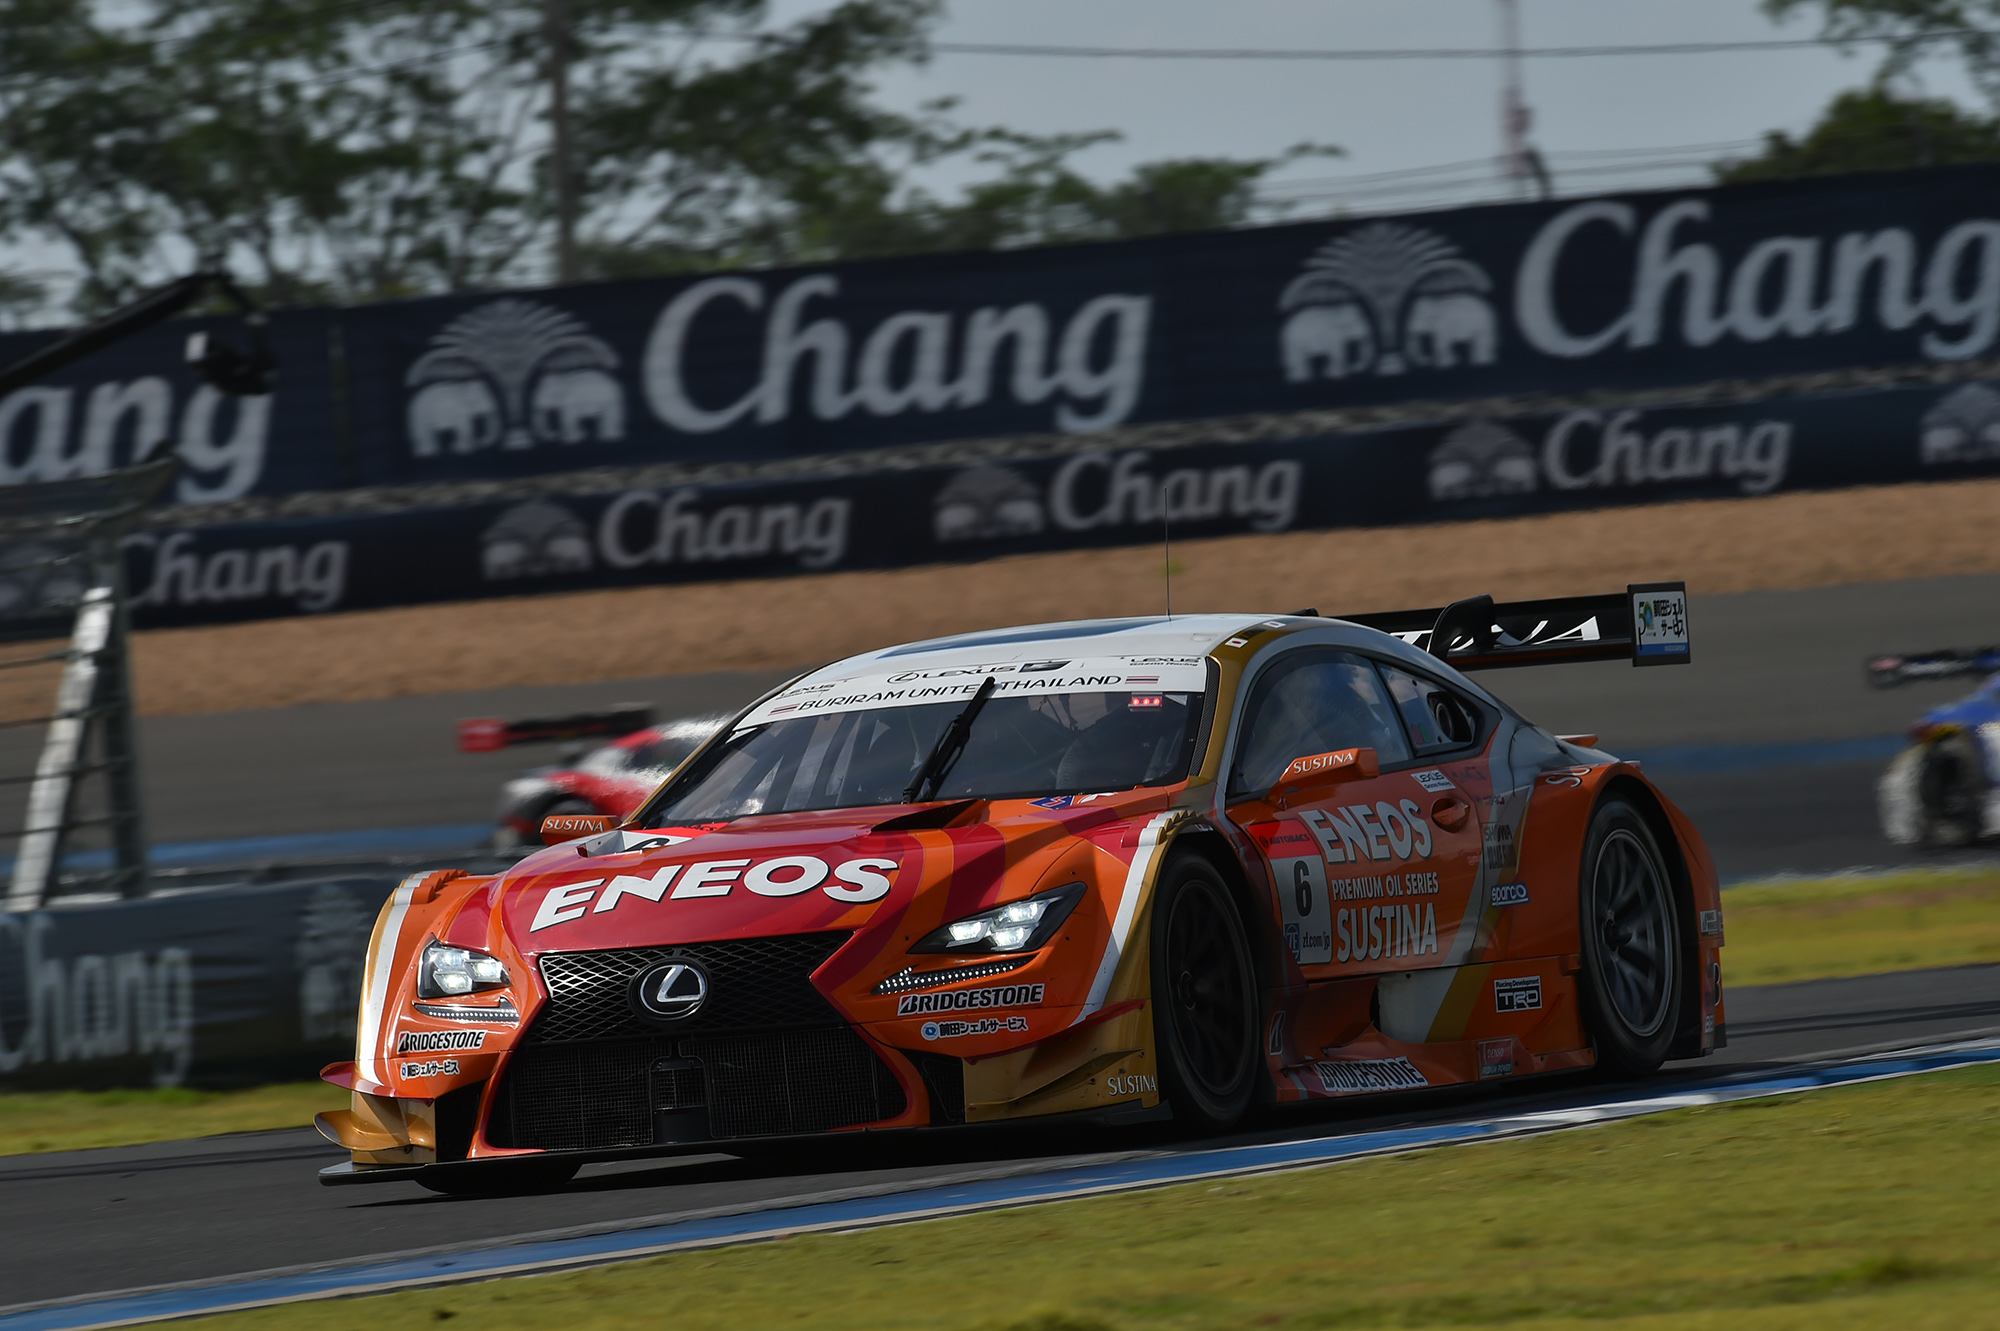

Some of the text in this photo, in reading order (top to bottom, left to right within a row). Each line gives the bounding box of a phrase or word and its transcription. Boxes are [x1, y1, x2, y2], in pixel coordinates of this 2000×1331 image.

[1511, 198, 2000, 360] Chang
[642, 274, 1154, 435] Chang
[1541, 408, 1794, 495] Chang
[1050, 450, 1302, 532] Chang
[598, 487, 852, 568] Chang
[921, 664, 1017, 679] LEXUS
[798, 690, 904, 712] BURIRAM
[908, 684, 981, 699] UNITE
[1001, 676, 1121, 691] THAILAND
[1293, 752, 1354, 775] SUSTINA
[545, 819, 604, 832] SUSTINA
[1299, 798, 1432, 864] ENEOS
[530, 856, 898, 933] ENEOS
[1294, 860, 1313, 918] 6
[1332, 872, 1439, 902] PREMIUM OIL SERIES
[1492, 884, 1527, 902] sparco
[1337, 902, 1438, 963] SUSTINA
[0, 913, 194, 1087] hang
[899, 984, 1044, 1015] BRIDGESTONE
[1498, 989, 1539, 1010] TRD
[398, 1031, 487, 1053] BRIDGESTONE
[1107, 1075, 1157, 1096] SUSTINA
[1315, 1059, 1426, 1088] BRIDGESTONE
